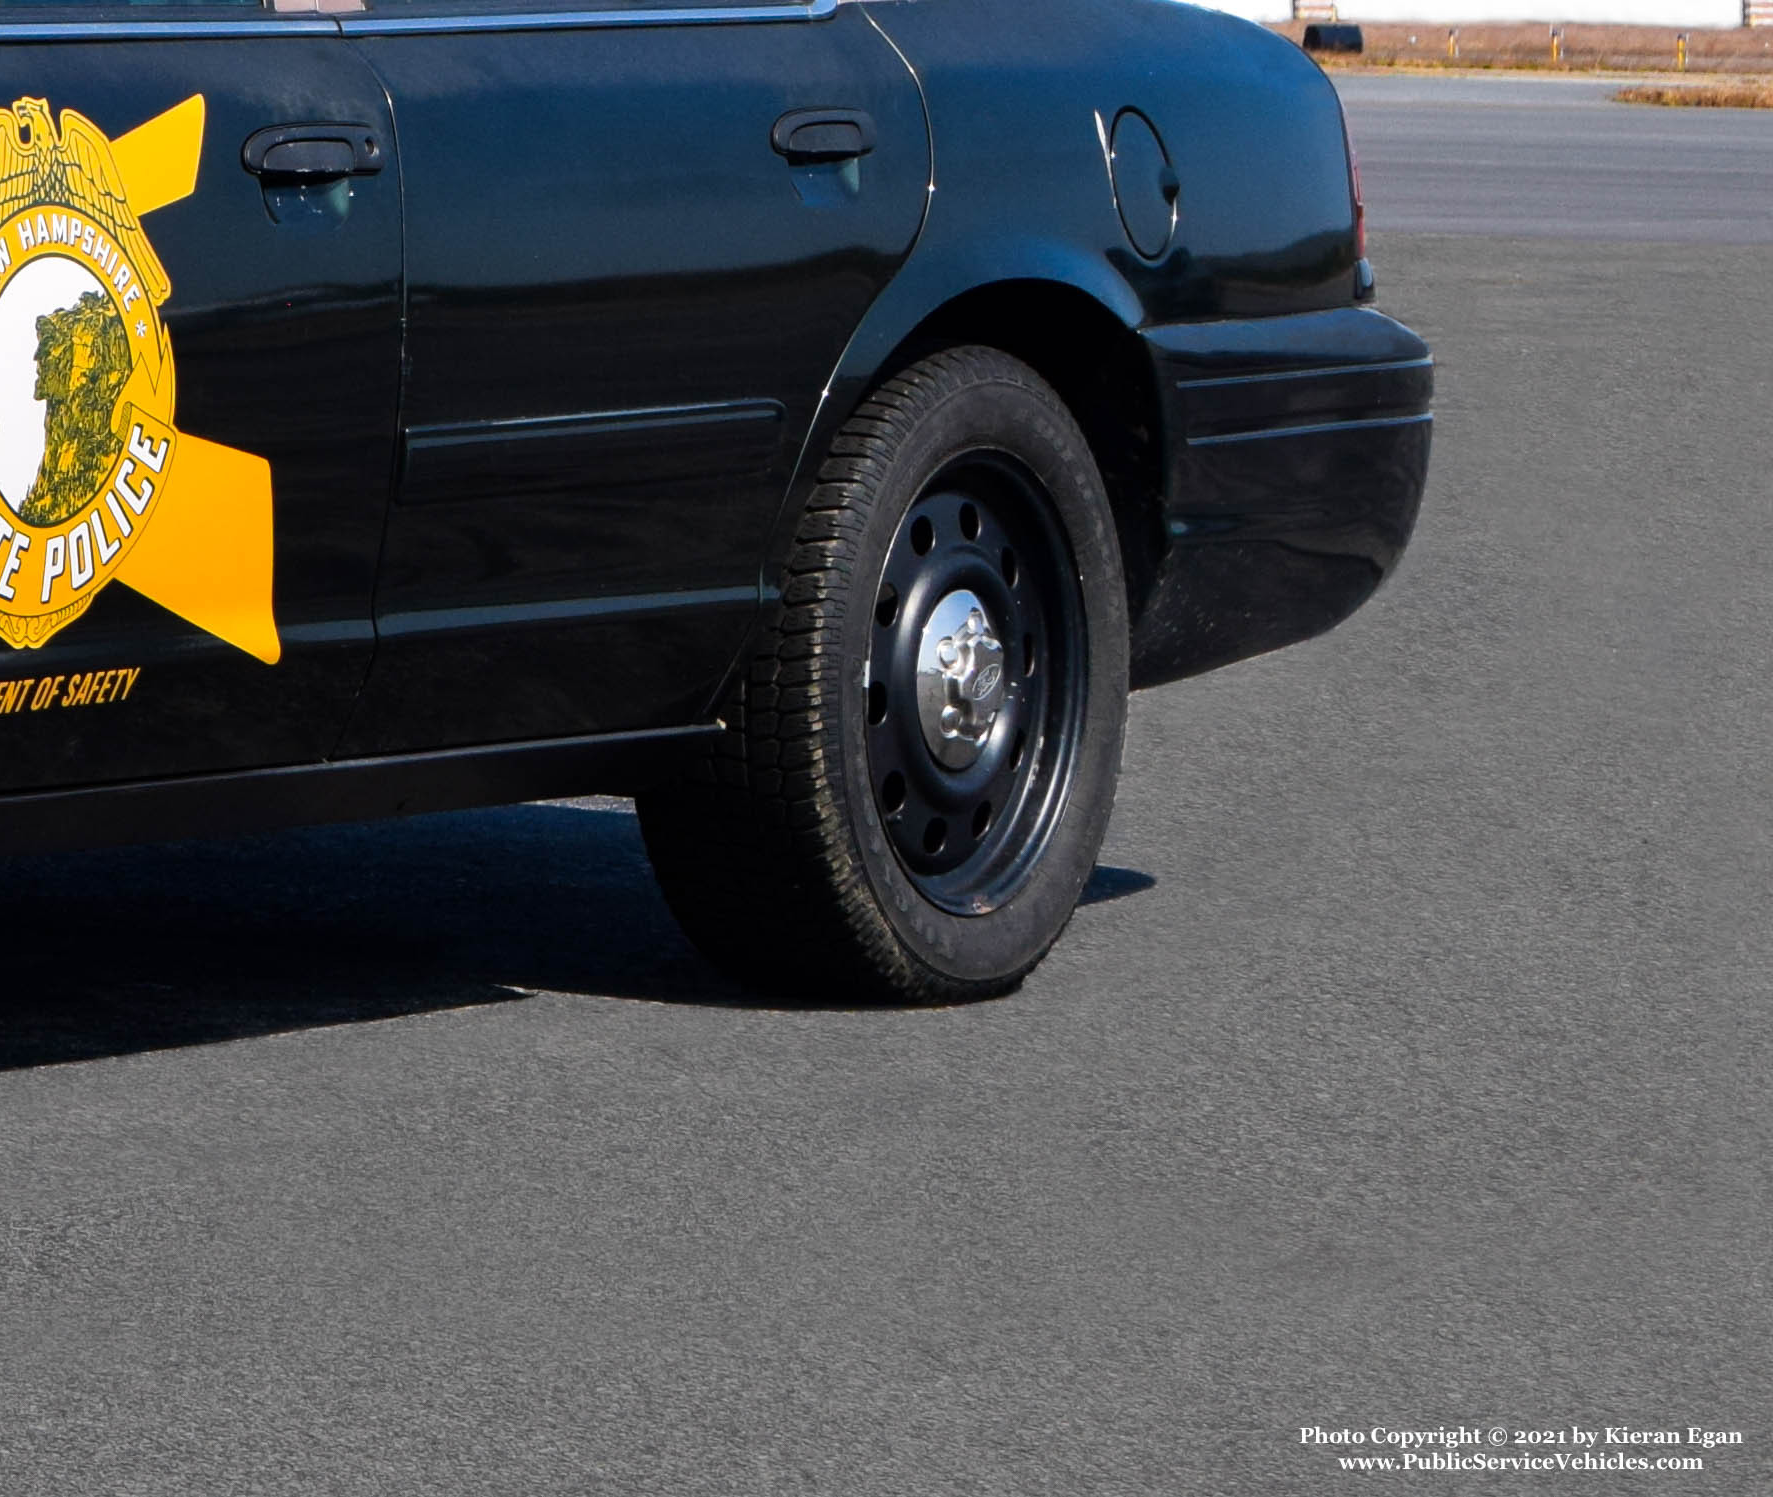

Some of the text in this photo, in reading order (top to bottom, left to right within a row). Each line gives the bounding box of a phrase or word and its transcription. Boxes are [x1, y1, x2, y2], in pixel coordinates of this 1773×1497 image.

[17, 213, 141, 312] HAMPSHIRE
[41, 422, 170, 604] POLICE
[30, 675, 65, 712] OF
[61, 667, 141, 708] SAFETY
